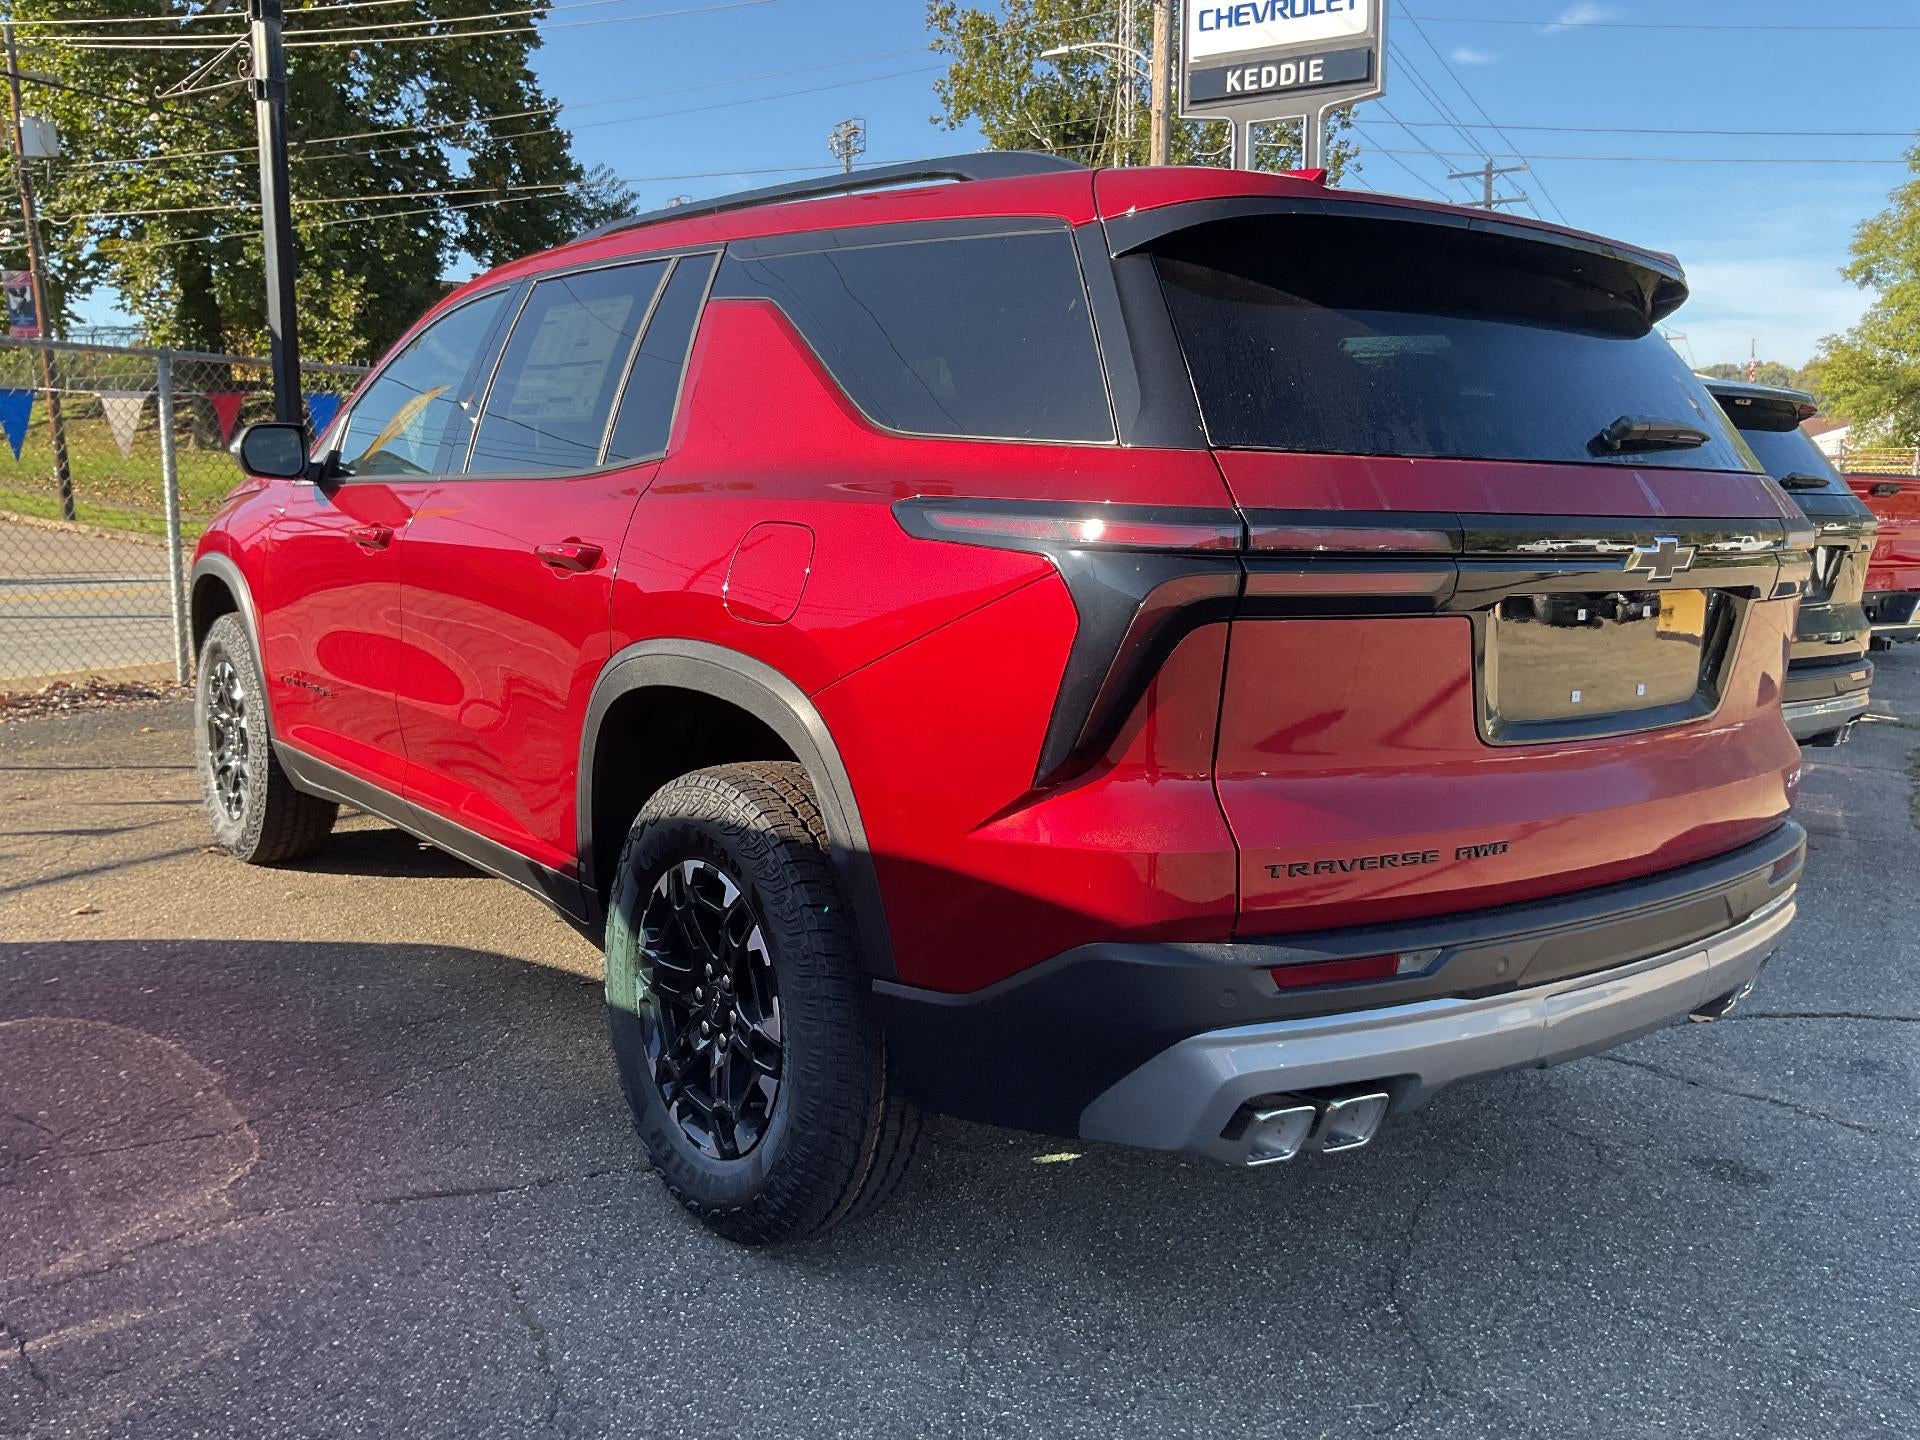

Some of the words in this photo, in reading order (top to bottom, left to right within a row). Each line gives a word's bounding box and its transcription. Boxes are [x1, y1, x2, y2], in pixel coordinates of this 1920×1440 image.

[1226, 59, 1325, 93] KEDDIE
[1264, 850, 1440, 879] TRAVERSE
[1455, 840, 1509, 860] AWD
